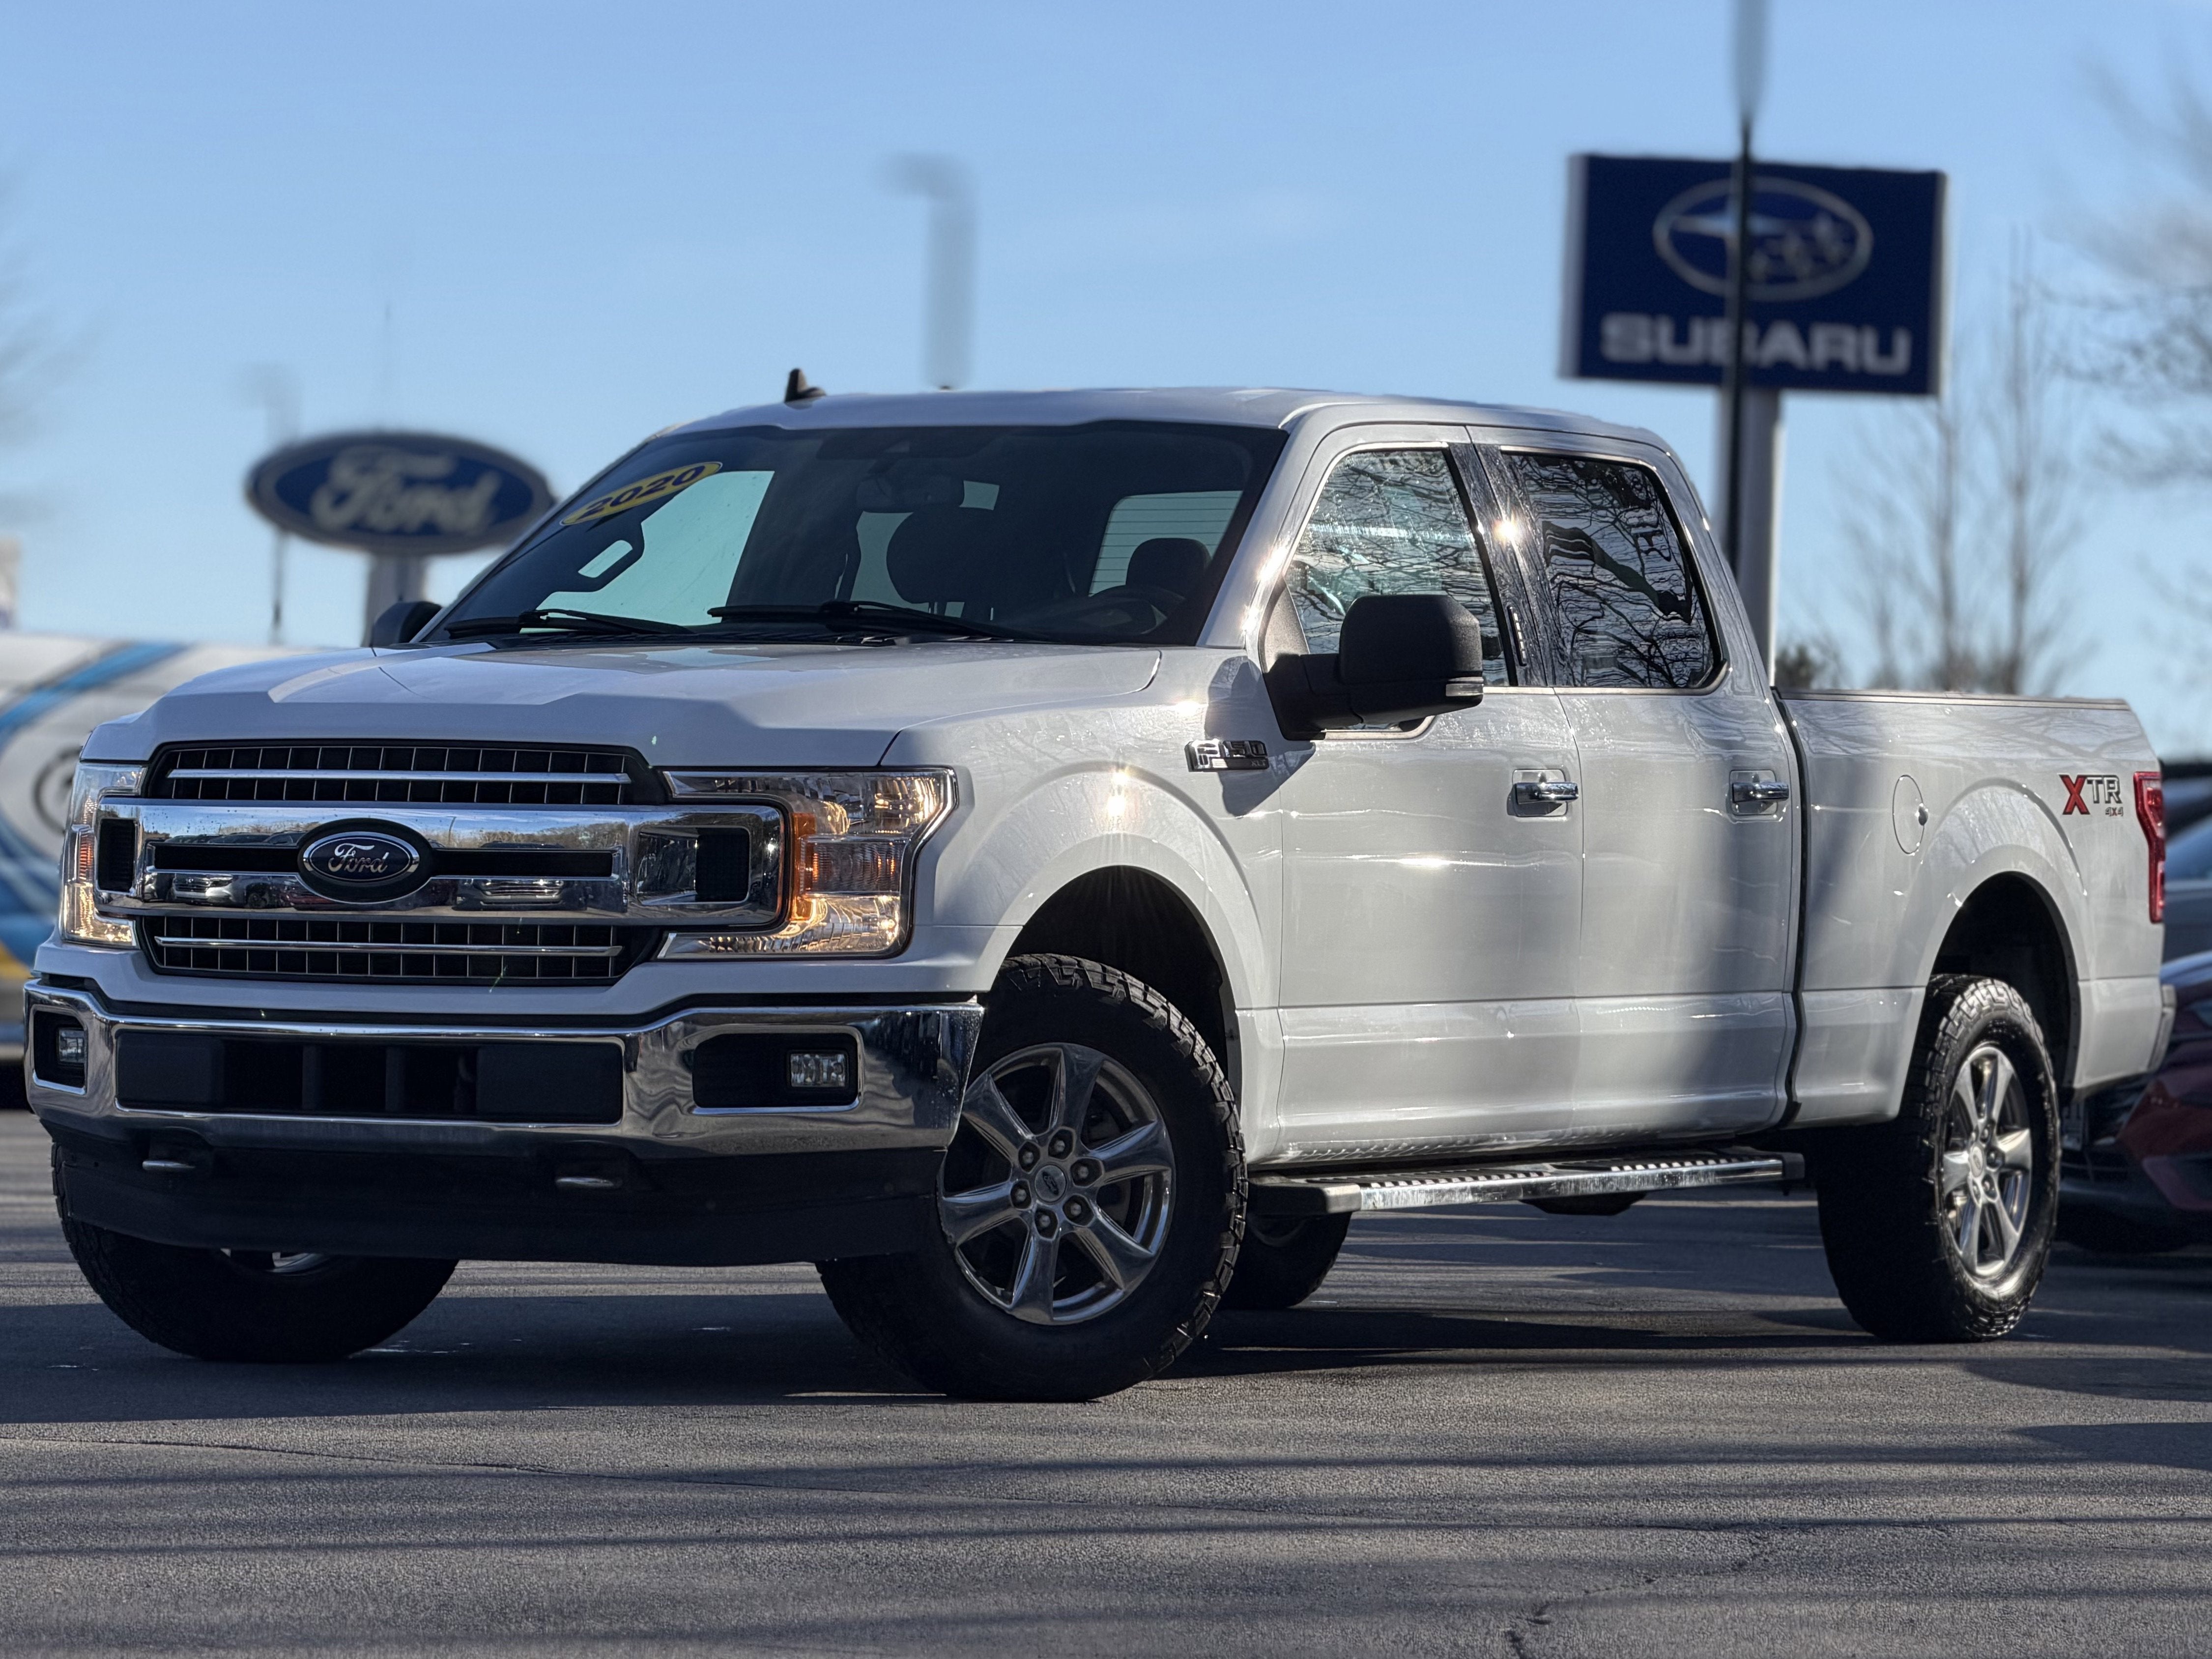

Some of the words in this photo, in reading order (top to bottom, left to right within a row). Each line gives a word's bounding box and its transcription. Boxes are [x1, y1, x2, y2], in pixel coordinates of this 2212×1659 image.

[313, 445, 501, 535] Ford
[576, 465, 705, 521] 2020
[2058, 773, 2123, 815] XTR
[328, 843, 390, 873] Ford
